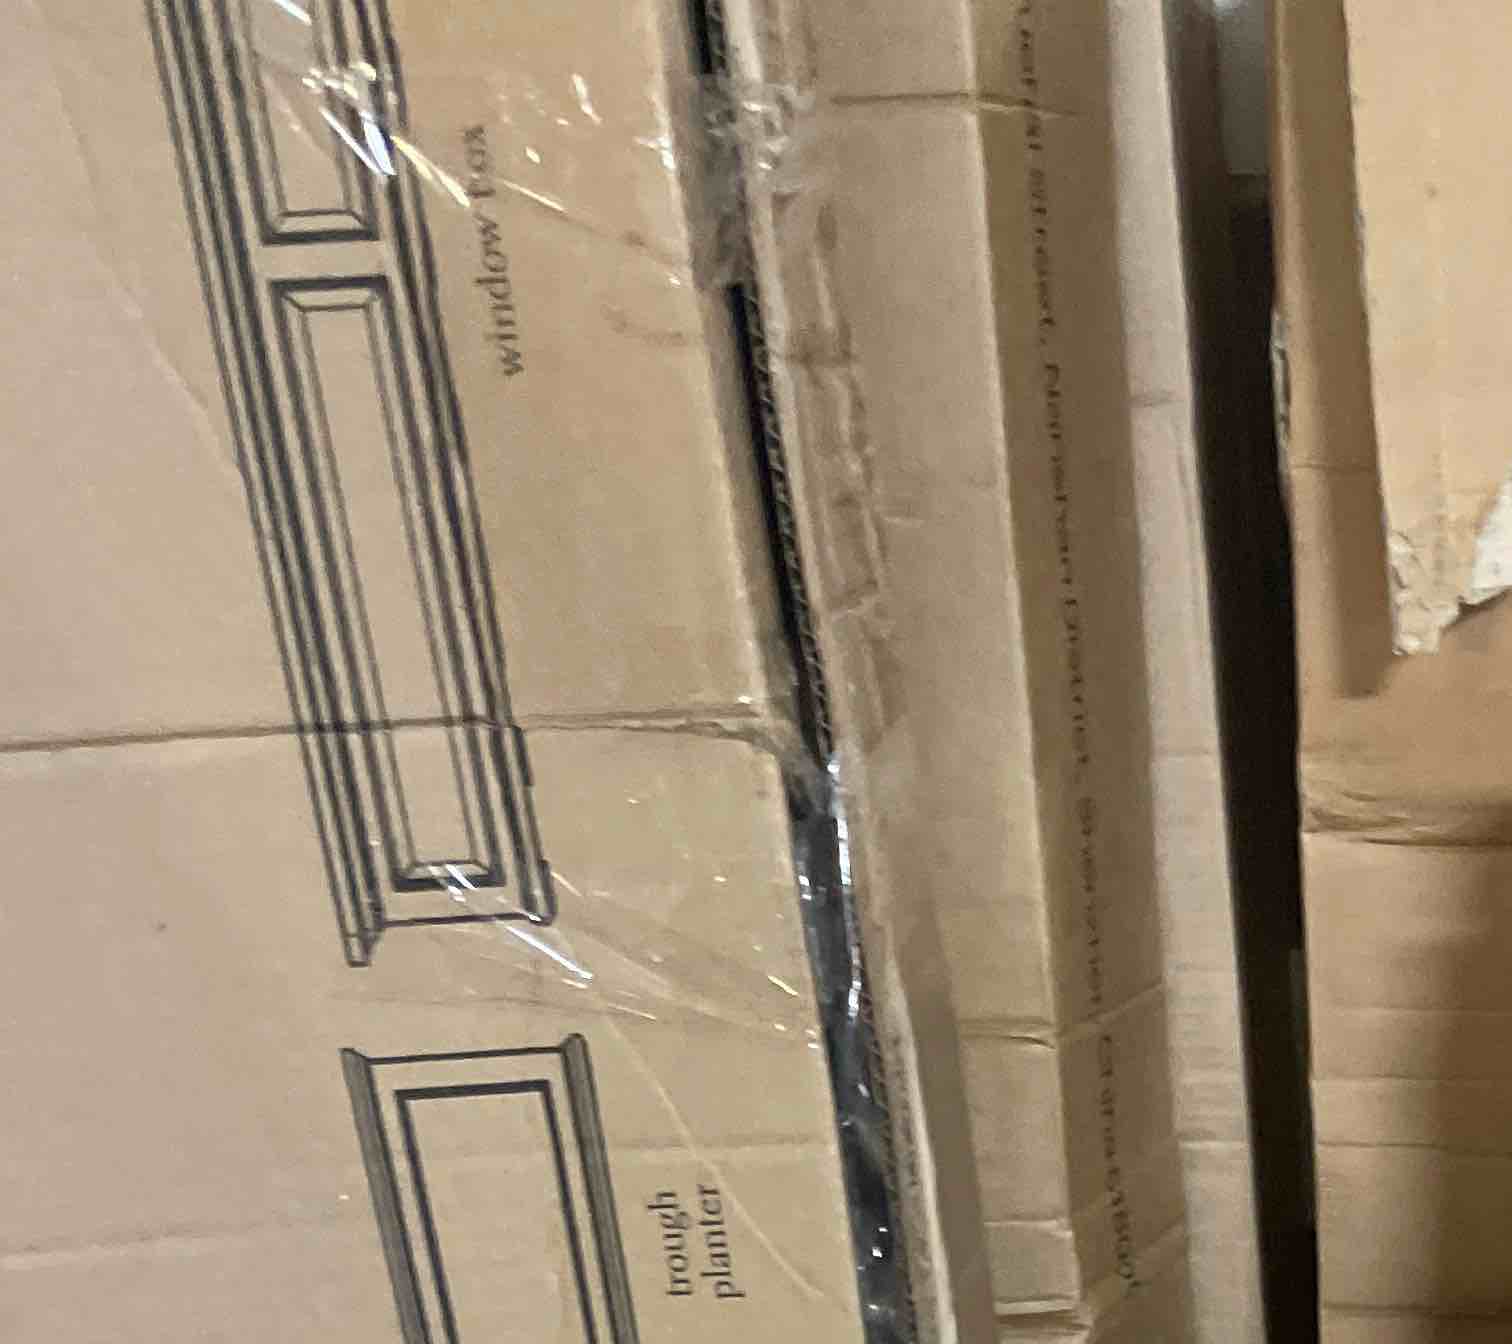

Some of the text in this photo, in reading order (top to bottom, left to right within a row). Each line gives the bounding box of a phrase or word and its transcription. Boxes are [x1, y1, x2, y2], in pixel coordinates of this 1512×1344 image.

[474, 212, 525, 376] window
[646, 1190, 693, 1295] trough
[697, 1184, 746, 1298] planter
